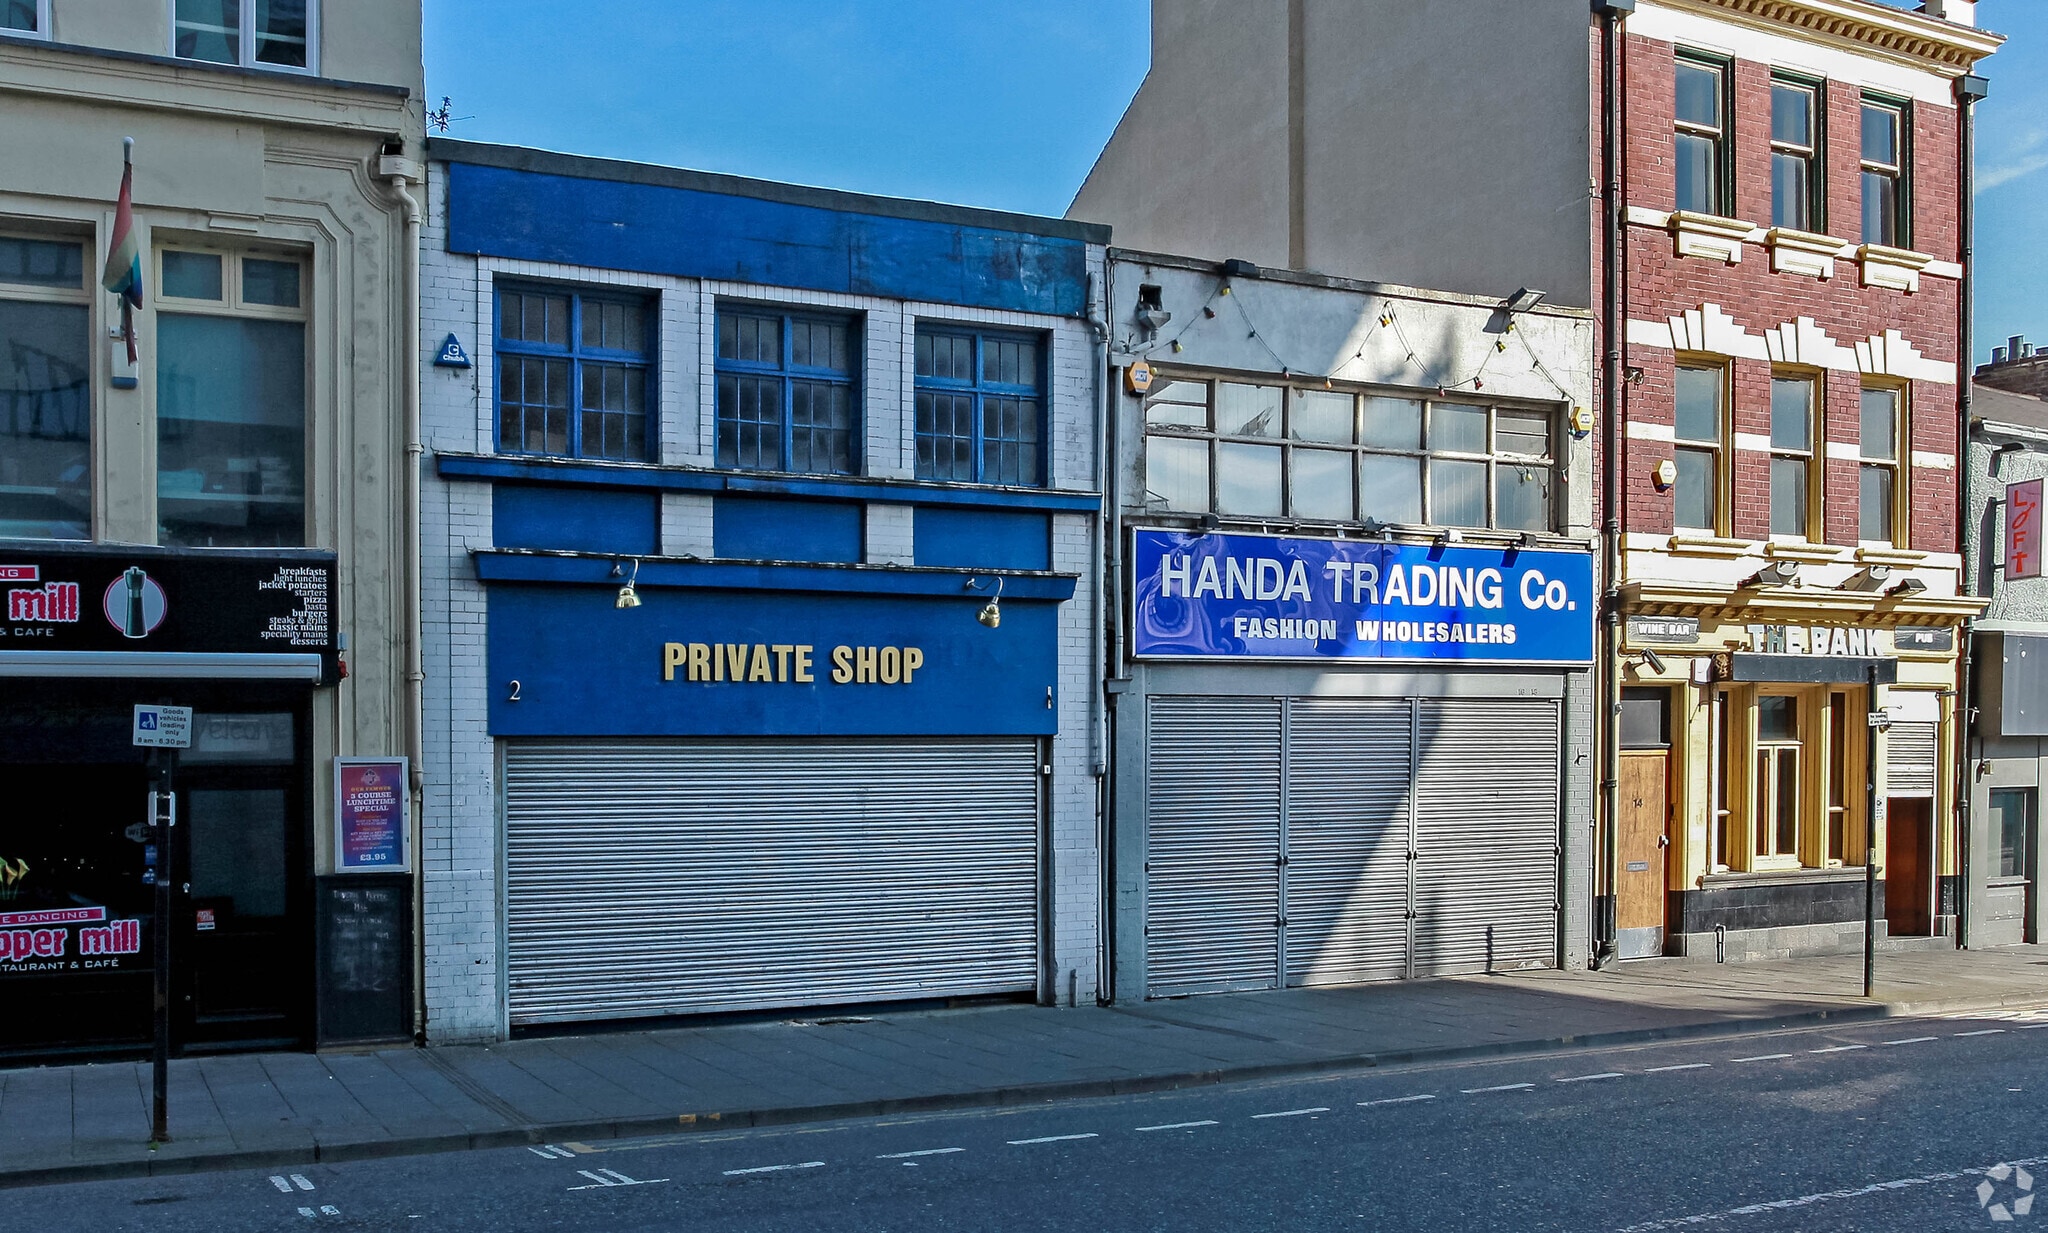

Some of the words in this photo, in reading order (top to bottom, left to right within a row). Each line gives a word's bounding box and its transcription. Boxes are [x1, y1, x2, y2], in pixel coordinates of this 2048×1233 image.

[280, 566, 327, 576] breakfasts
[274, 573, 293, 583] light
[294, 572, 327, 582] lunches
[1161, 553, 1312, 602] HANDA
[1326, 561, 1503, 609] TRADING
[1520, 568, 1577, 611] Co.
[259, 580, 286, 590] jacket
[288, 582, 327, 591] potatoes
[9, 582, 79, 622] mill
[304, 596, 327, 605] pizza
[292, 609, 327, 619] burgers
[306, 616, 327, 625] grills
[269, 622, 299, 631] classic
[300, 623, 327, 631] mains
[1234, 617, 1337, 641] FASHION
[1355, 620, 1517, 645] WHOLESALERS
[1638, 622, 1665, 635] WINE
[1668, 623, 1690, 636] BAR
[261, 630, 300, 640] speciality
[1747, 624, 1802, 654] THE
[1810, 627, 1883, 656] BANK
[1914, 633, 1934, 643] PUB
[664, 642, 814, 684] PRIVATE
[832, 645, 924, 684] SHOP
[508, 680, 522, 700] 2
[1632, 799, 1643, 808] 14
[360, 853, 386, 861] £3.95
[18, 911, 88, 922] DANCING
[80, 919, 140, 956] mill
[0, 962, 65, 972] TAURANT
[70, 960, 79, 969] &
[84, 957, 119, 968] CAFÉ
